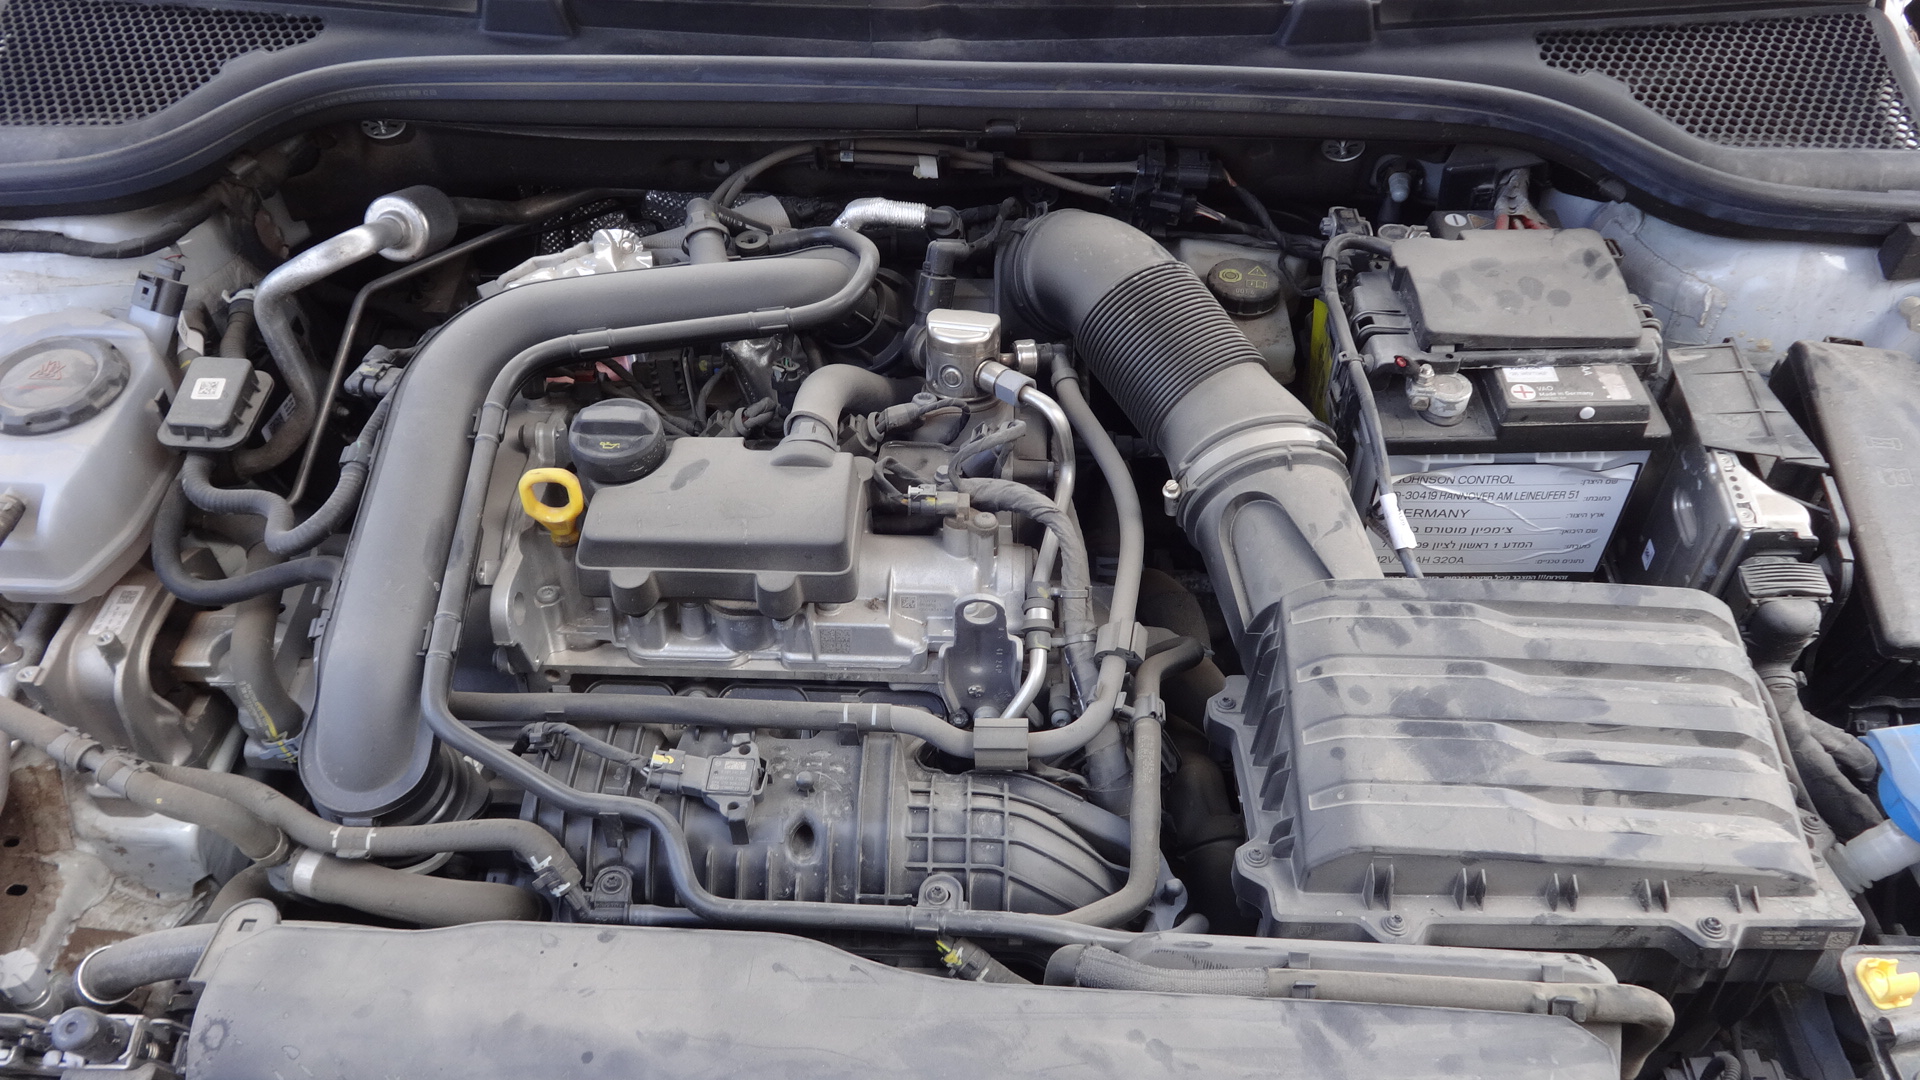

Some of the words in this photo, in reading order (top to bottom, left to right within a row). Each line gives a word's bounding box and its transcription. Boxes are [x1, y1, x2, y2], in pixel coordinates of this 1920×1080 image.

[1457, 474, 1515, 485] CONTROL
[1439, 491, 1495, 501] HANNOVER
[1496, 491, 1513, 500] AM
[1514, 490, 1566, 501] LEINEUFER
[1568, 490, 1580, 499] 51
[1403, 508, 1471, 518] ERMANY
[1424, 526, 1467, 534] מוטורס
[1431, 540, 1456, 551] לציון
[1459, 541, 1488, 551] ראשון
[1503, 541, 1533, 549] המדע
